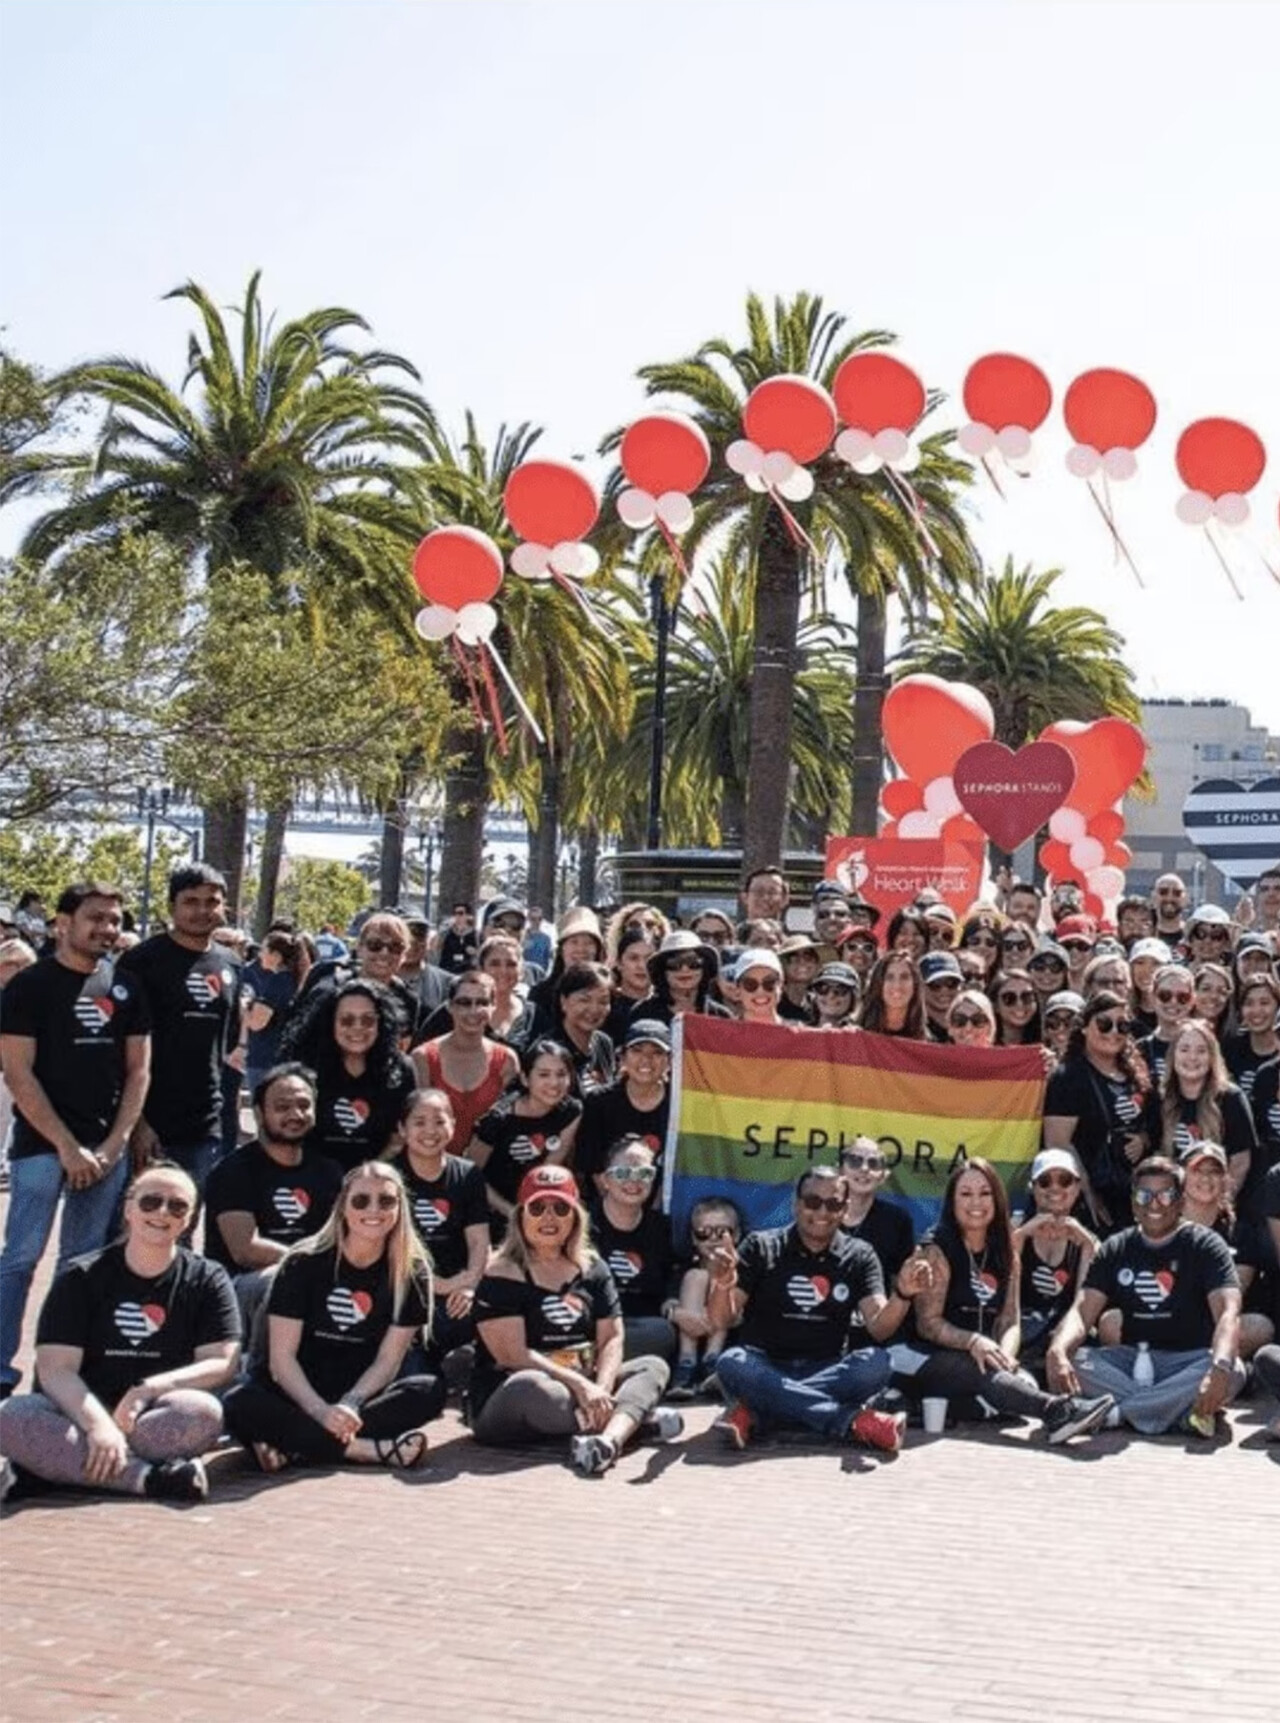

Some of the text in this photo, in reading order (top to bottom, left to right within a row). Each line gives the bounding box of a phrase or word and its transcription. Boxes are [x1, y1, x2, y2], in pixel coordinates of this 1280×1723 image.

[963, 782, 1019, 793] SEPHORA
[1215, 812, 1279, 824] SEPHORA
[874, 873, 922, 893] Heart
